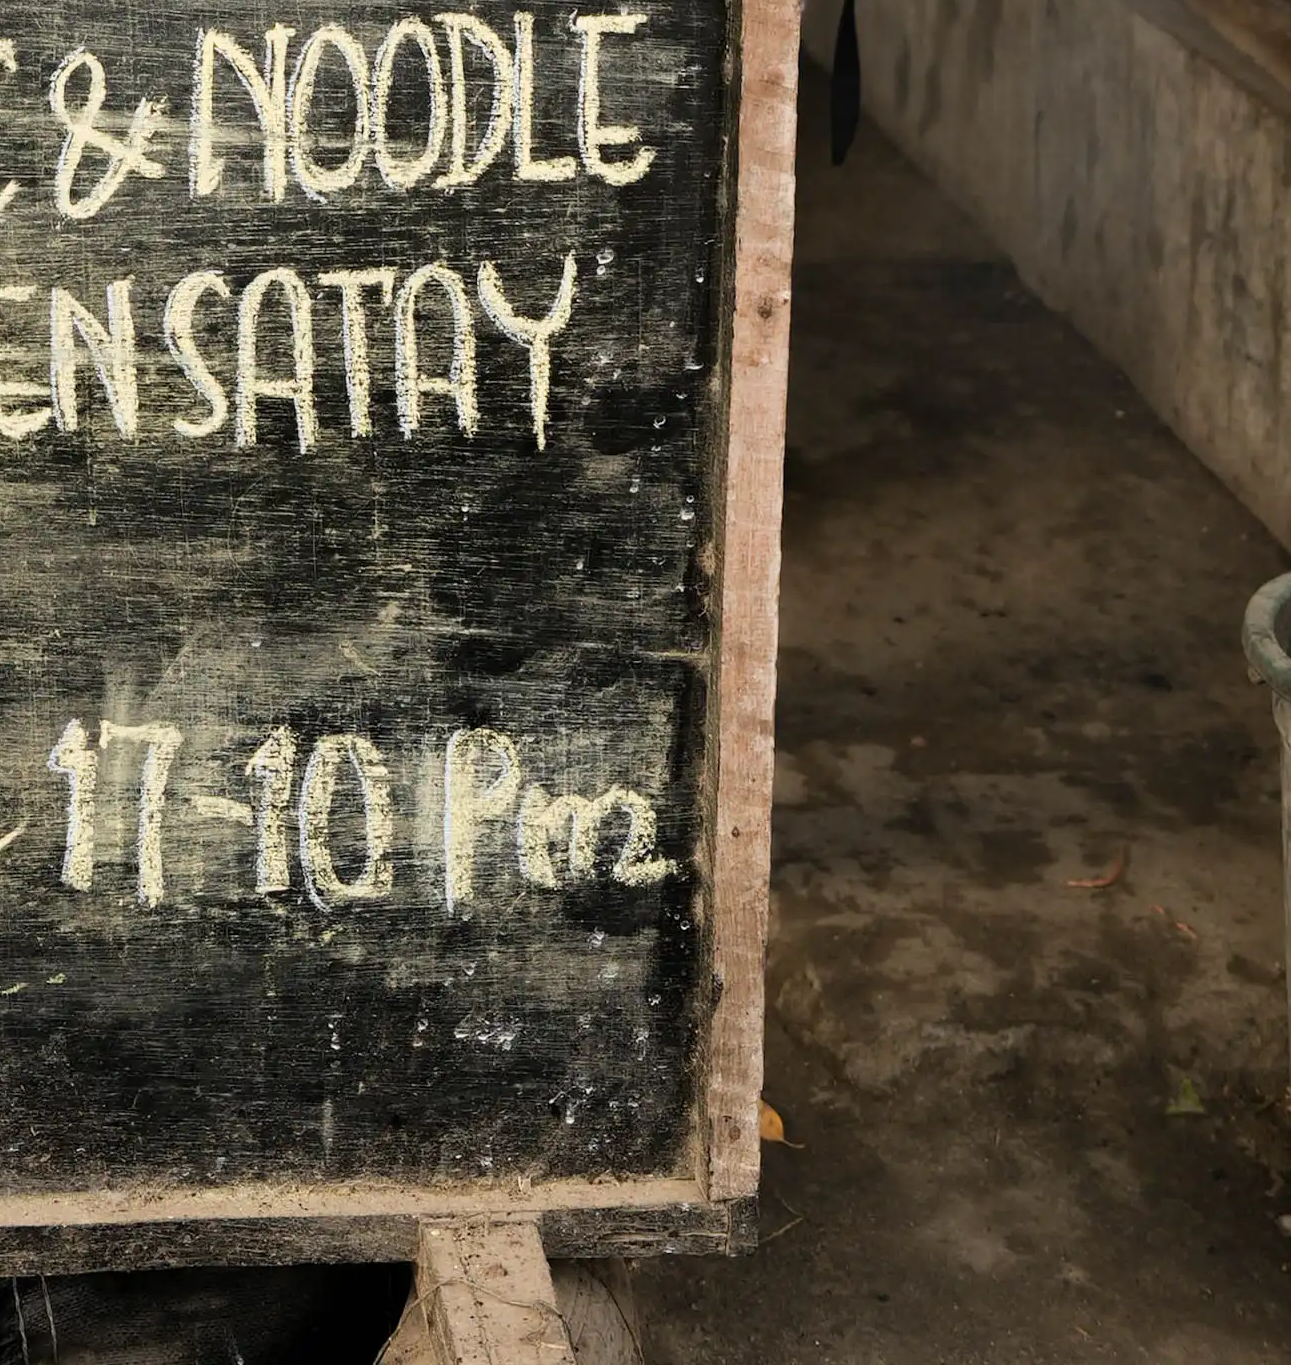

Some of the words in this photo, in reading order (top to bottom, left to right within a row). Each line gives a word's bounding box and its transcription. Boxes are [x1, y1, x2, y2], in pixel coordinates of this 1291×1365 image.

[48, 46, 167, 221] &
[190, 9, 657, 204] NOODLE
[163, 251, 578, 455] SATAY
